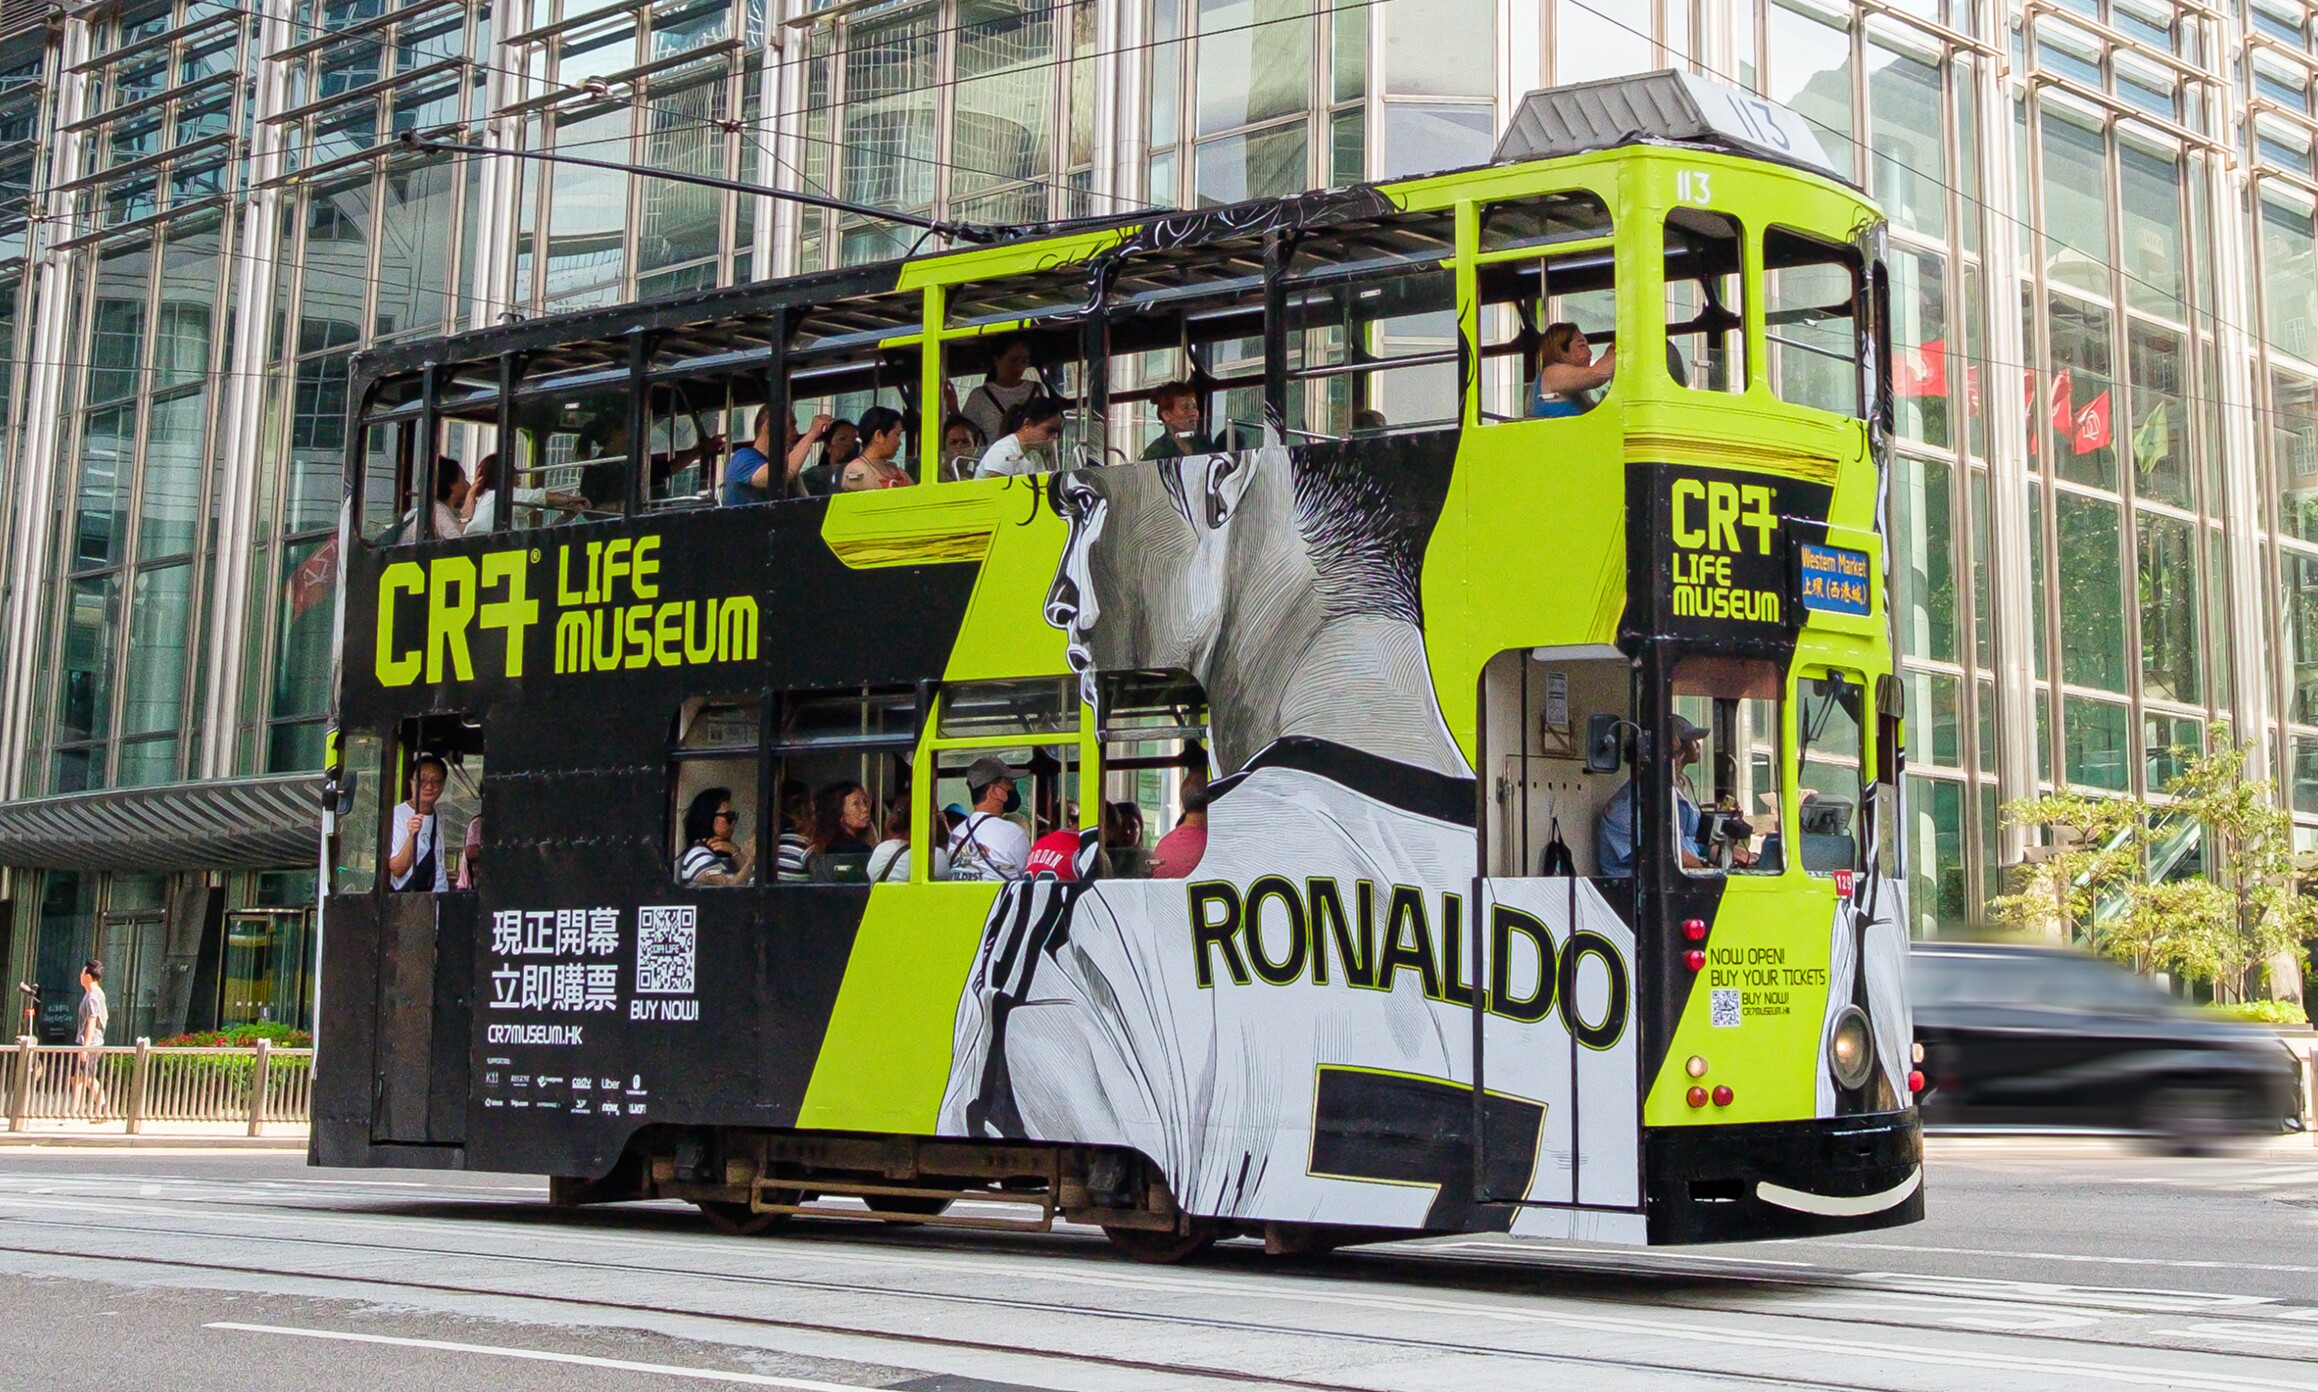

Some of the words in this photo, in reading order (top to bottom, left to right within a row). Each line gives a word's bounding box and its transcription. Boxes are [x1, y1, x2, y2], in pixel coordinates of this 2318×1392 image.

[1726, 93, 1791, 151] 113
[1677, 169, 1711, 205] 113
[557, 535, 661, 606] LIFE
[1672, 552, 1732, 586] LIFE
[1838, 553, 1867, 578] Market
[1672, 585, 1780, 623] MUSEUM
[555, 595, 759, 674] MUSEUM
[1836, 874, 1852, 890] 129
[491, 906, 620, 956] 現正開幕
[1187, 874, 1630, 1051] RONALDO
[1710, 948, 1744, 965] NOW
[1747, 948, 1785, 965] OPEN!
[489, 962, 619, 1011] 立即購票
[1711, 970, 1739, 987] BUY
[1743, 969, 1779, 986] YOUR
[1782, 969, 1826, 986] TICKETS
[630, 1000, 659, 1020] BUY
[661, 1000, 699, 1020] NOW!
[1742, 992, 1762, 1005] BUY
[1764, 992, 1790, 1005] NOW!
[488, 1024, 583, 1045] CR7MUSEUM.HK
[601, 1077, 620, 1090] Uber
